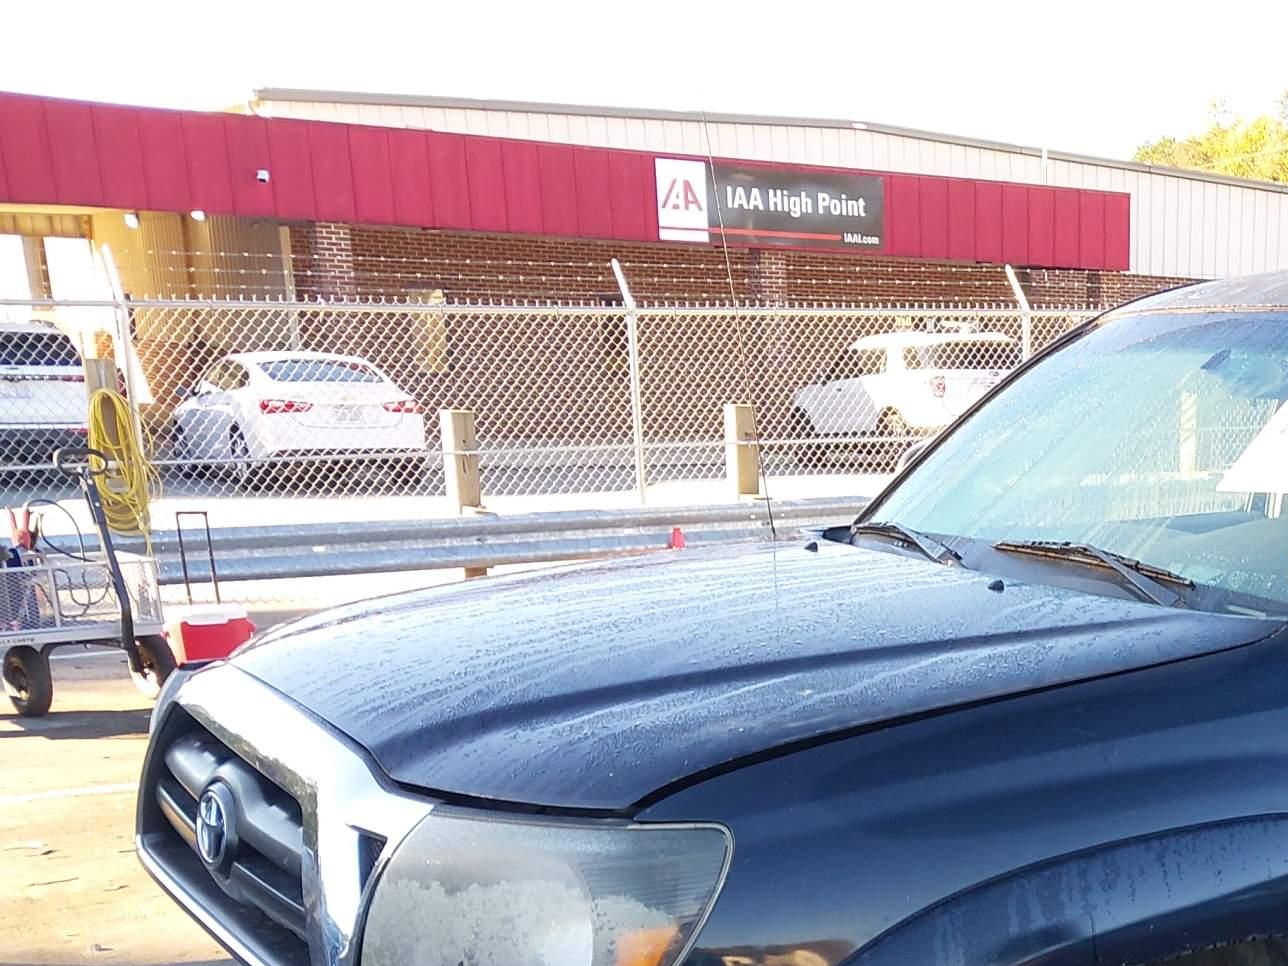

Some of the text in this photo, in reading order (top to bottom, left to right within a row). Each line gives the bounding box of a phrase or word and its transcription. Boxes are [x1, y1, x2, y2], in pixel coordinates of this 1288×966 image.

[725, 185, 866, 218] IAA High Point
